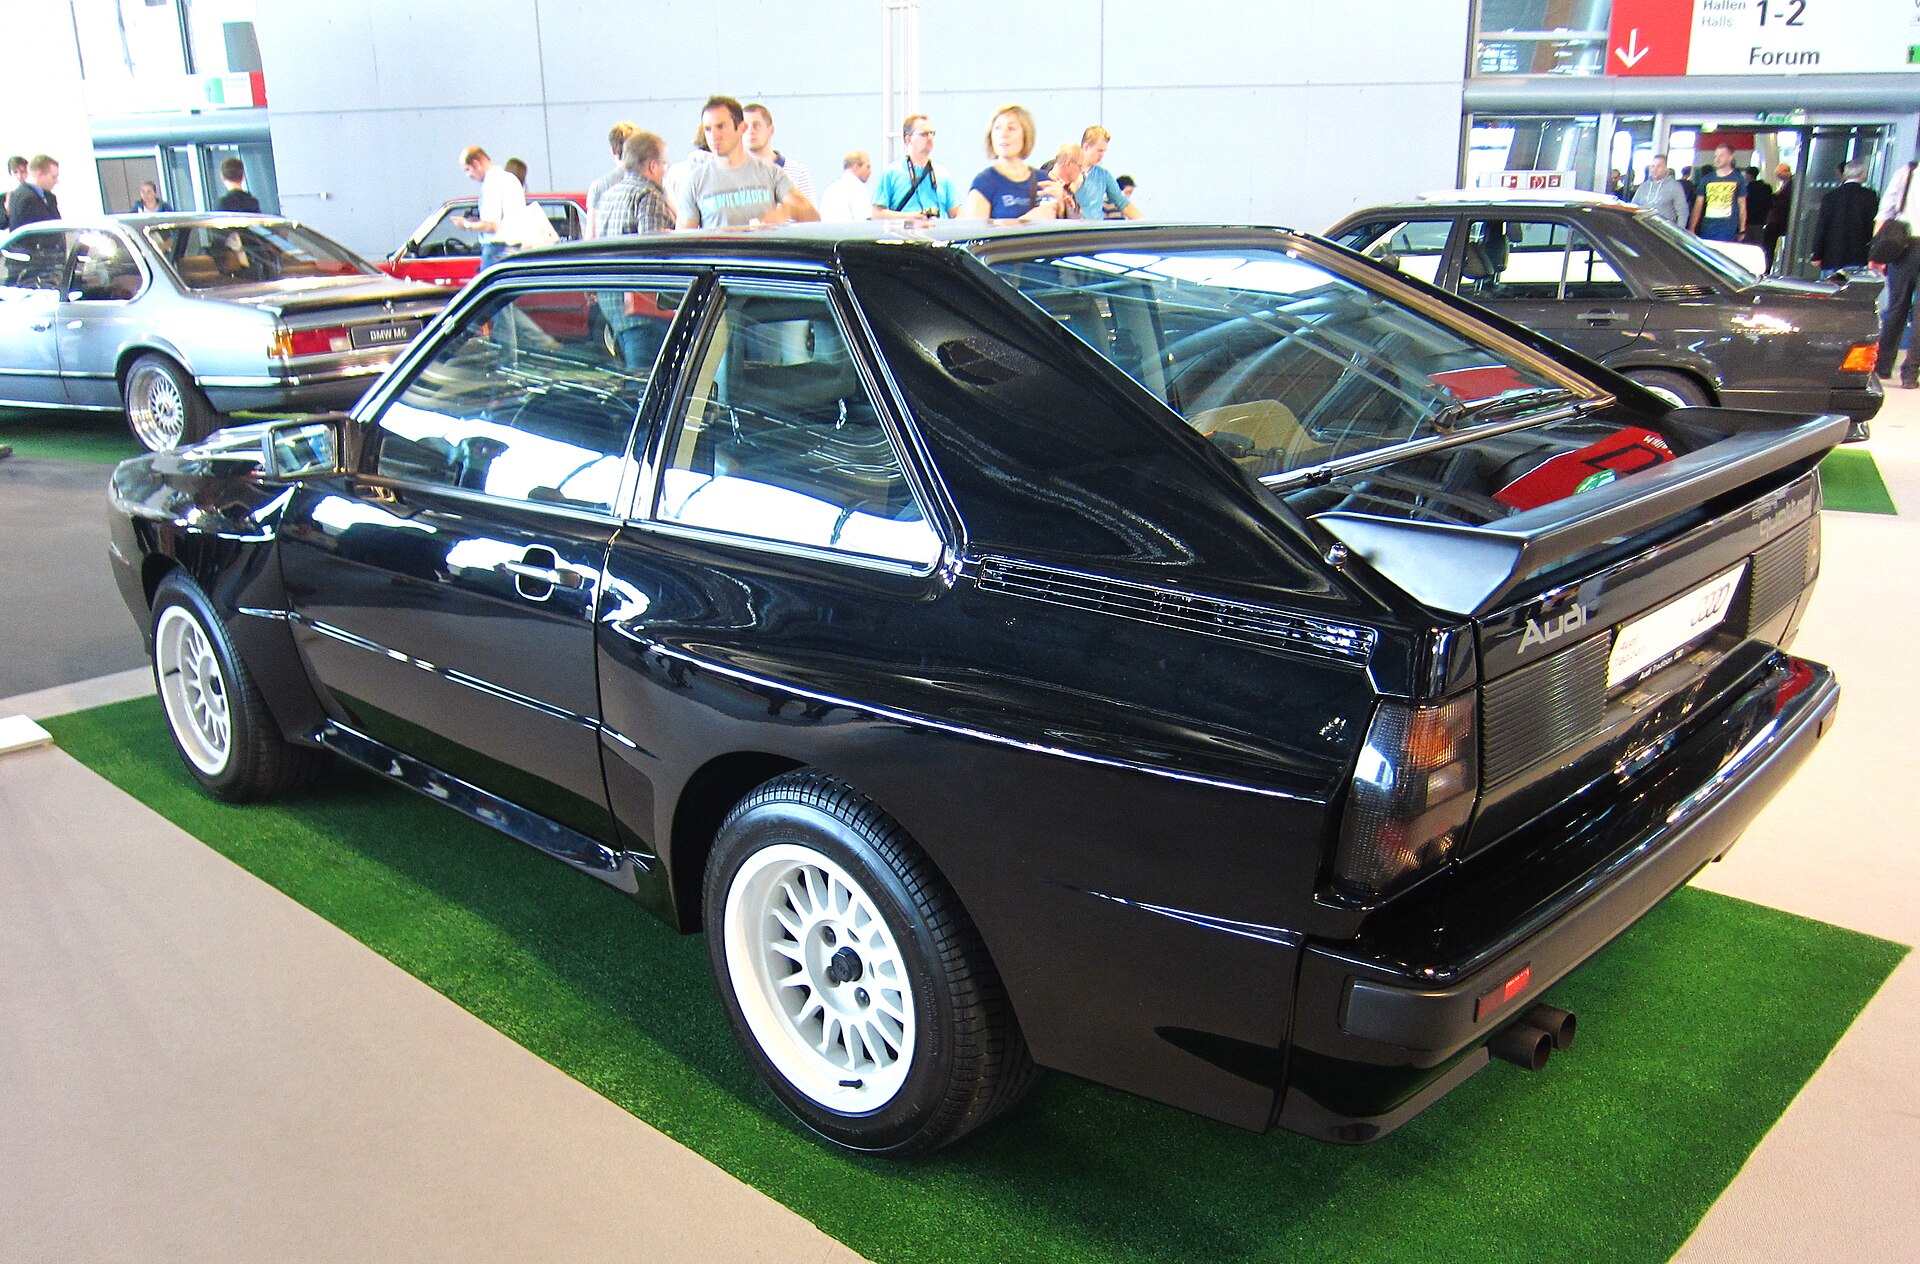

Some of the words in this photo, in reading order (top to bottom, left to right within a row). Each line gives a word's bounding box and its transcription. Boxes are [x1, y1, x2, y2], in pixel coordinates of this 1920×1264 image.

[1701, 15, 1733, 27] Halls
[1703, 0, 1746, 10] Hallen
[1757, 0, 1807, 26] 1-2
[1749, 46, 1820, 65] Forum
[369, 328, 392, 341] BMW
[1517, 603, 1587, 655] Audi
